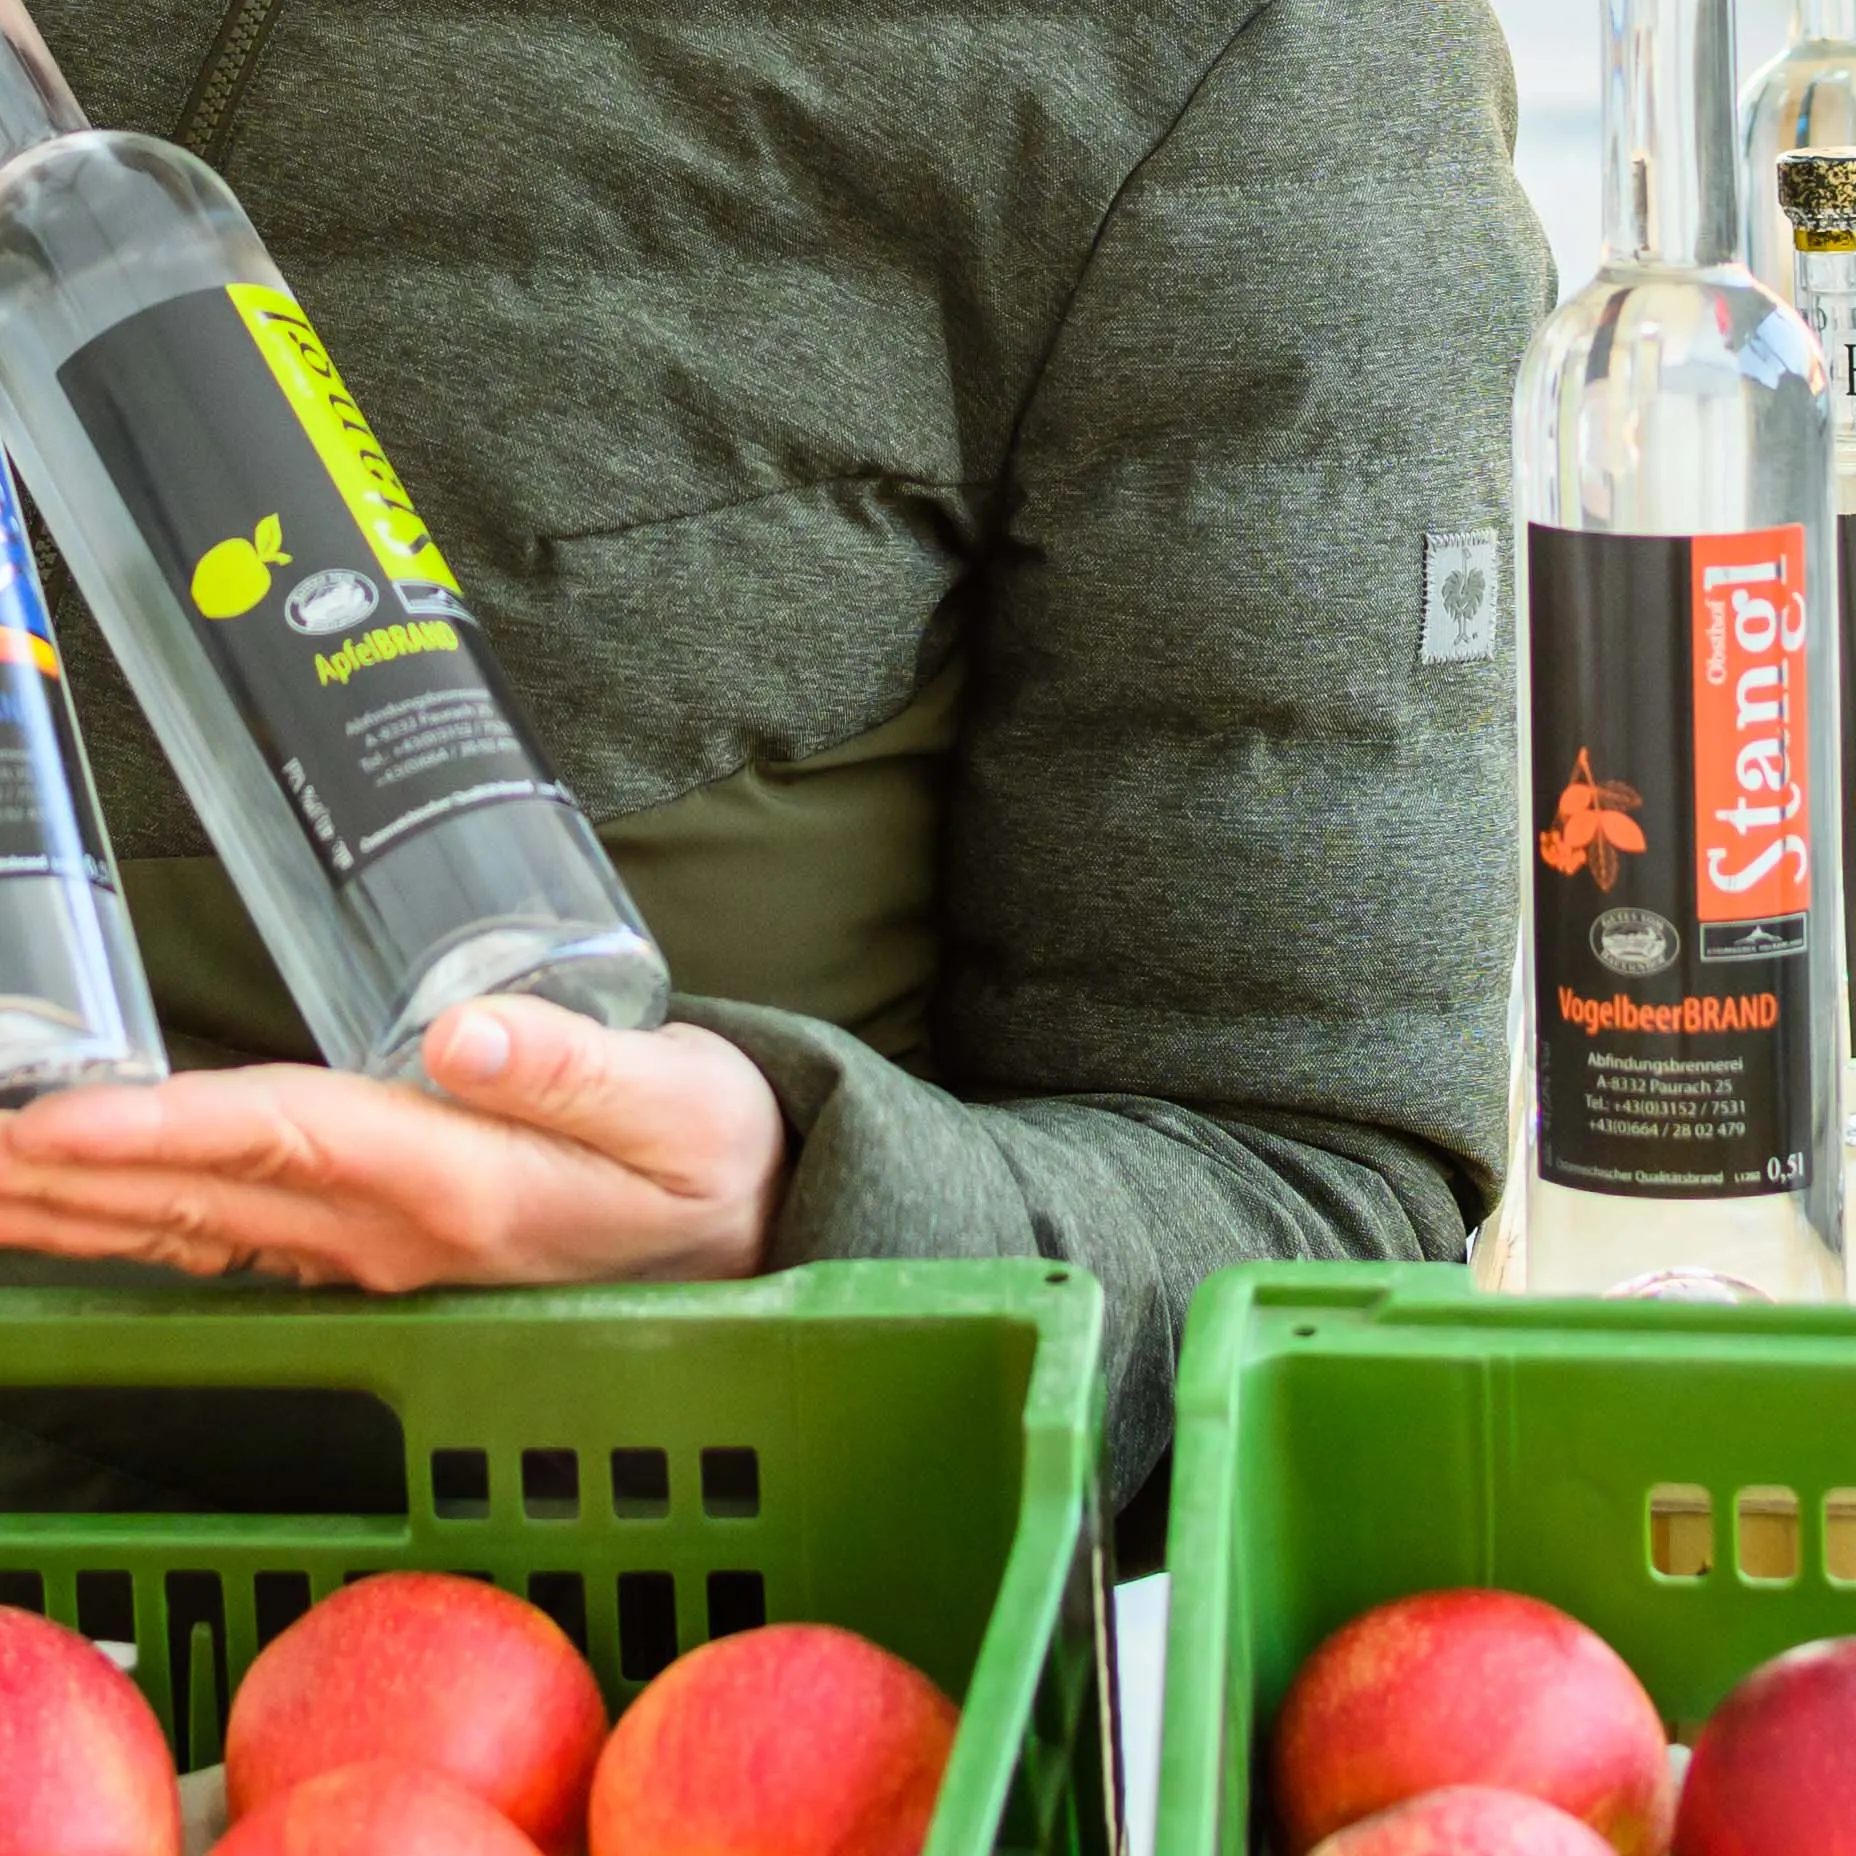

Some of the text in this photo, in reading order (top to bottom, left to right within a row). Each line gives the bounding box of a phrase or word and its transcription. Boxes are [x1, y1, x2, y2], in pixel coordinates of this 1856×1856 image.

[313, 619, 460, 687] ApfelBRAND
[1705, 600, 1728, 686] Obsthof
[1704, 554, 1807, 894] Stangl
[1557, 985, 1779, 1037] VogelbeerBRAND
[1587, 1052, 1744, 1075] Abfindungsbrennerei
[1649, 1079, 1712, 1094] Paurach
[1714, 1078, 1733, 1093] 25
[1712, 1100, 1746, 1115] 7531
[1672, 1122, 1691, 1138] 28
[1694, 1122, 1713, 1137] 02
[1717, 1121, 1746, 1136] 479
